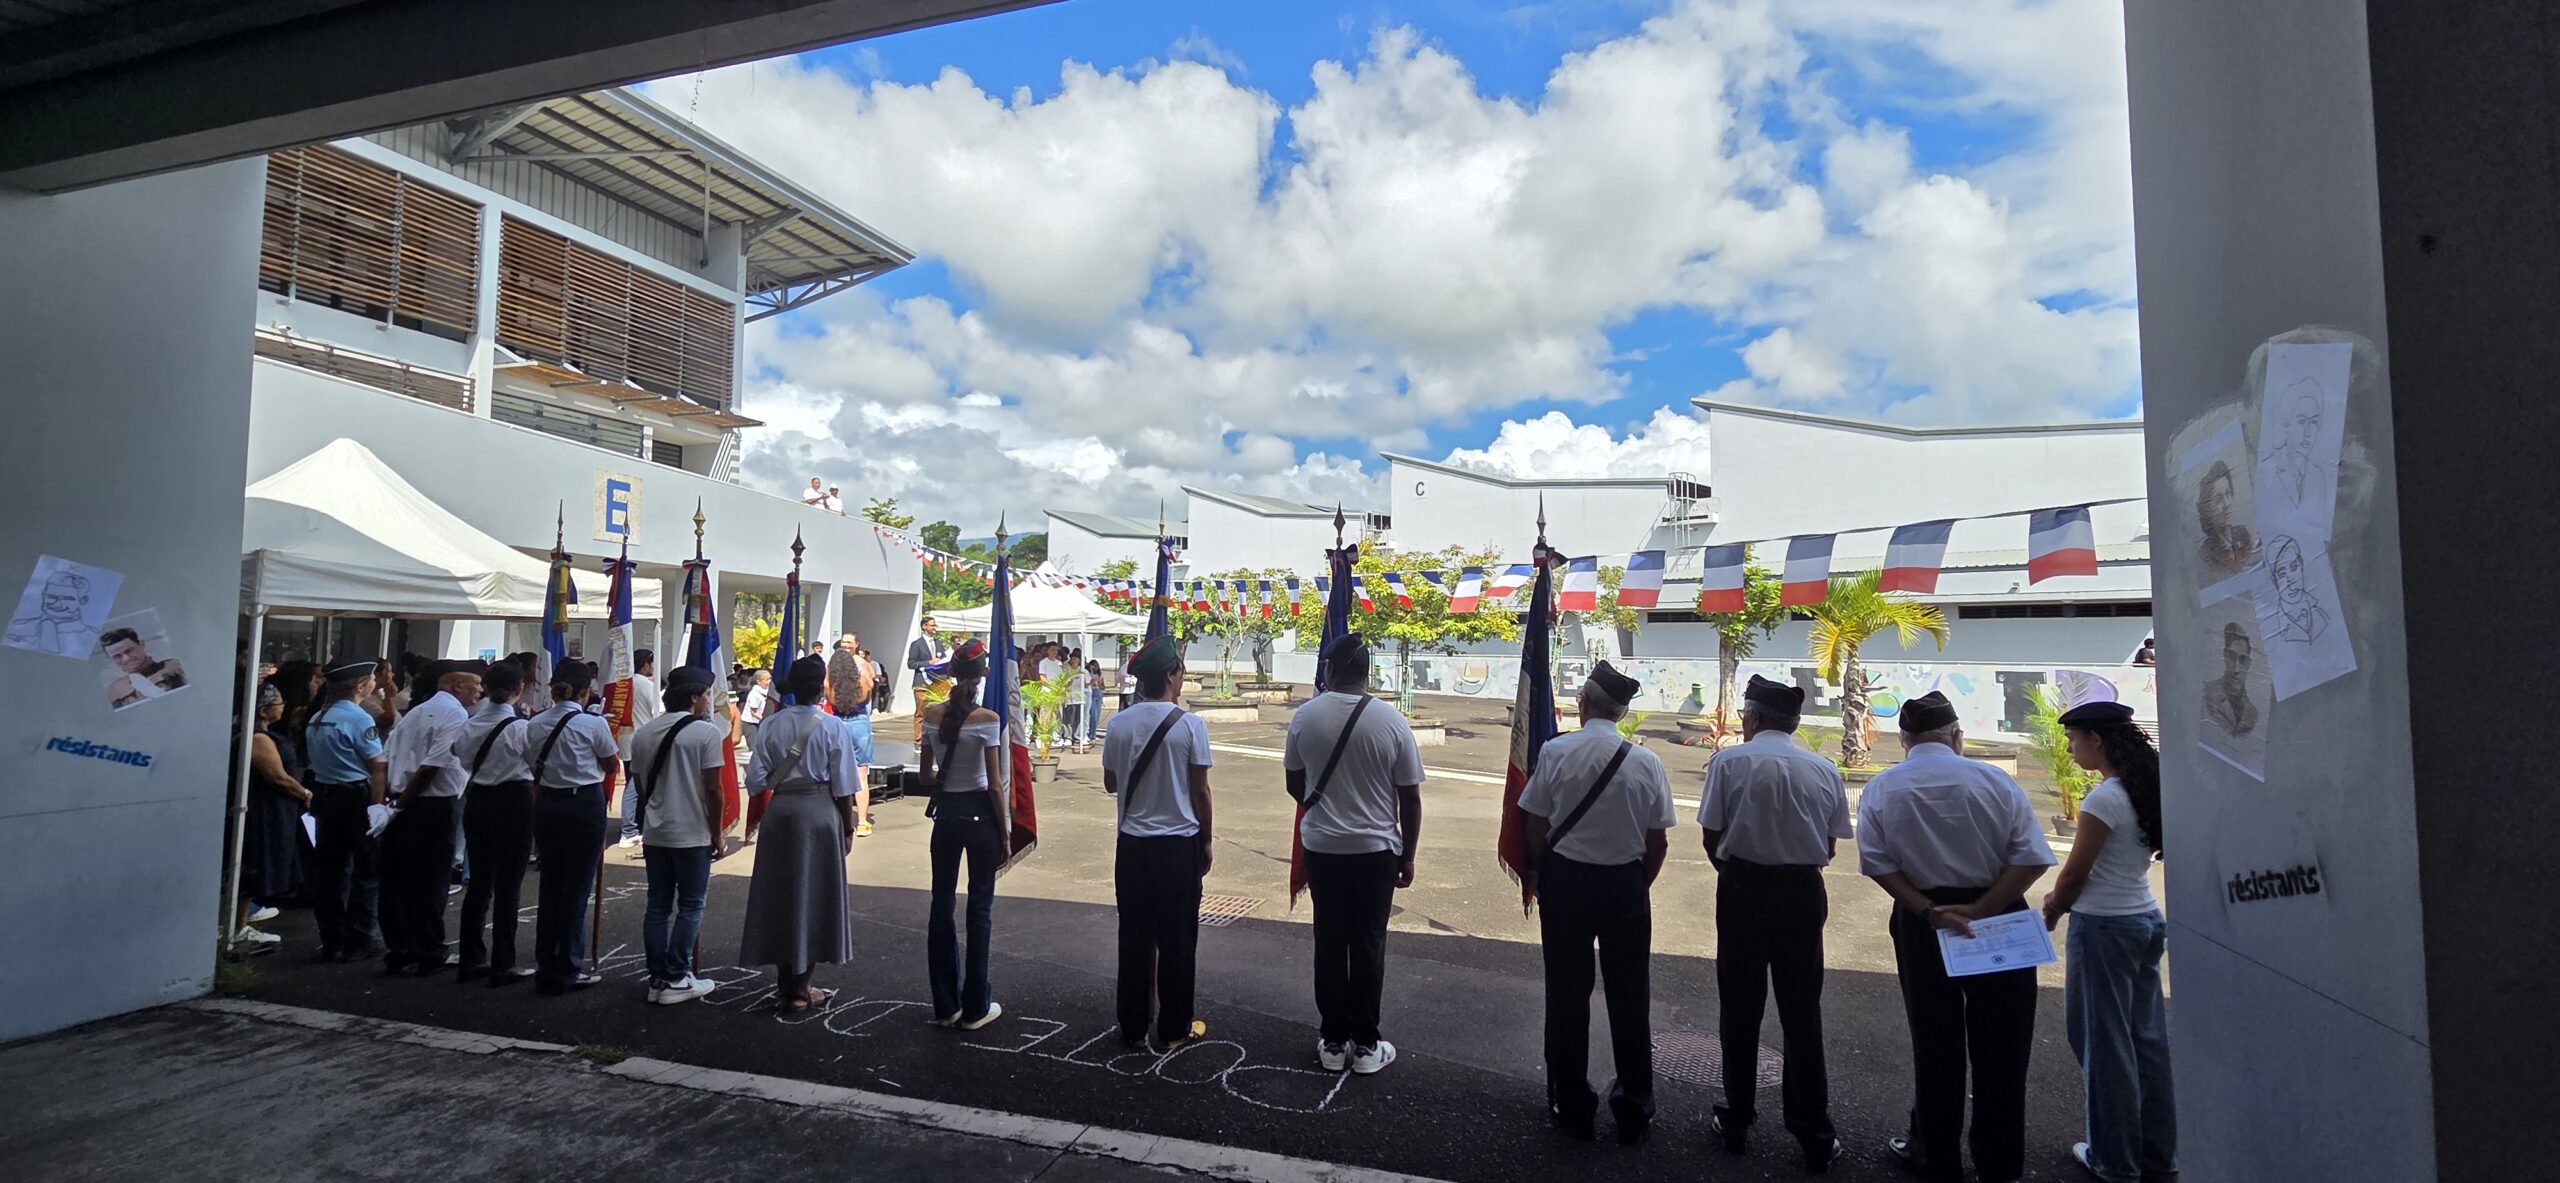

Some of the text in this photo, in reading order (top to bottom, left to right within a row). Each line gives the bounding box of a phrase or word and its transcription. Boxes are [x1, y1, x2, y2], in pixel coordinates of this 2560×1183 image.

[606, 478, 631, 534] E
[1415, 481, 1425, 497] C
[46, 736, 152, 767] résistants
[2227, 865, 2320, 904] résistants
[958, 1016, 1354, 1114] PORTE
